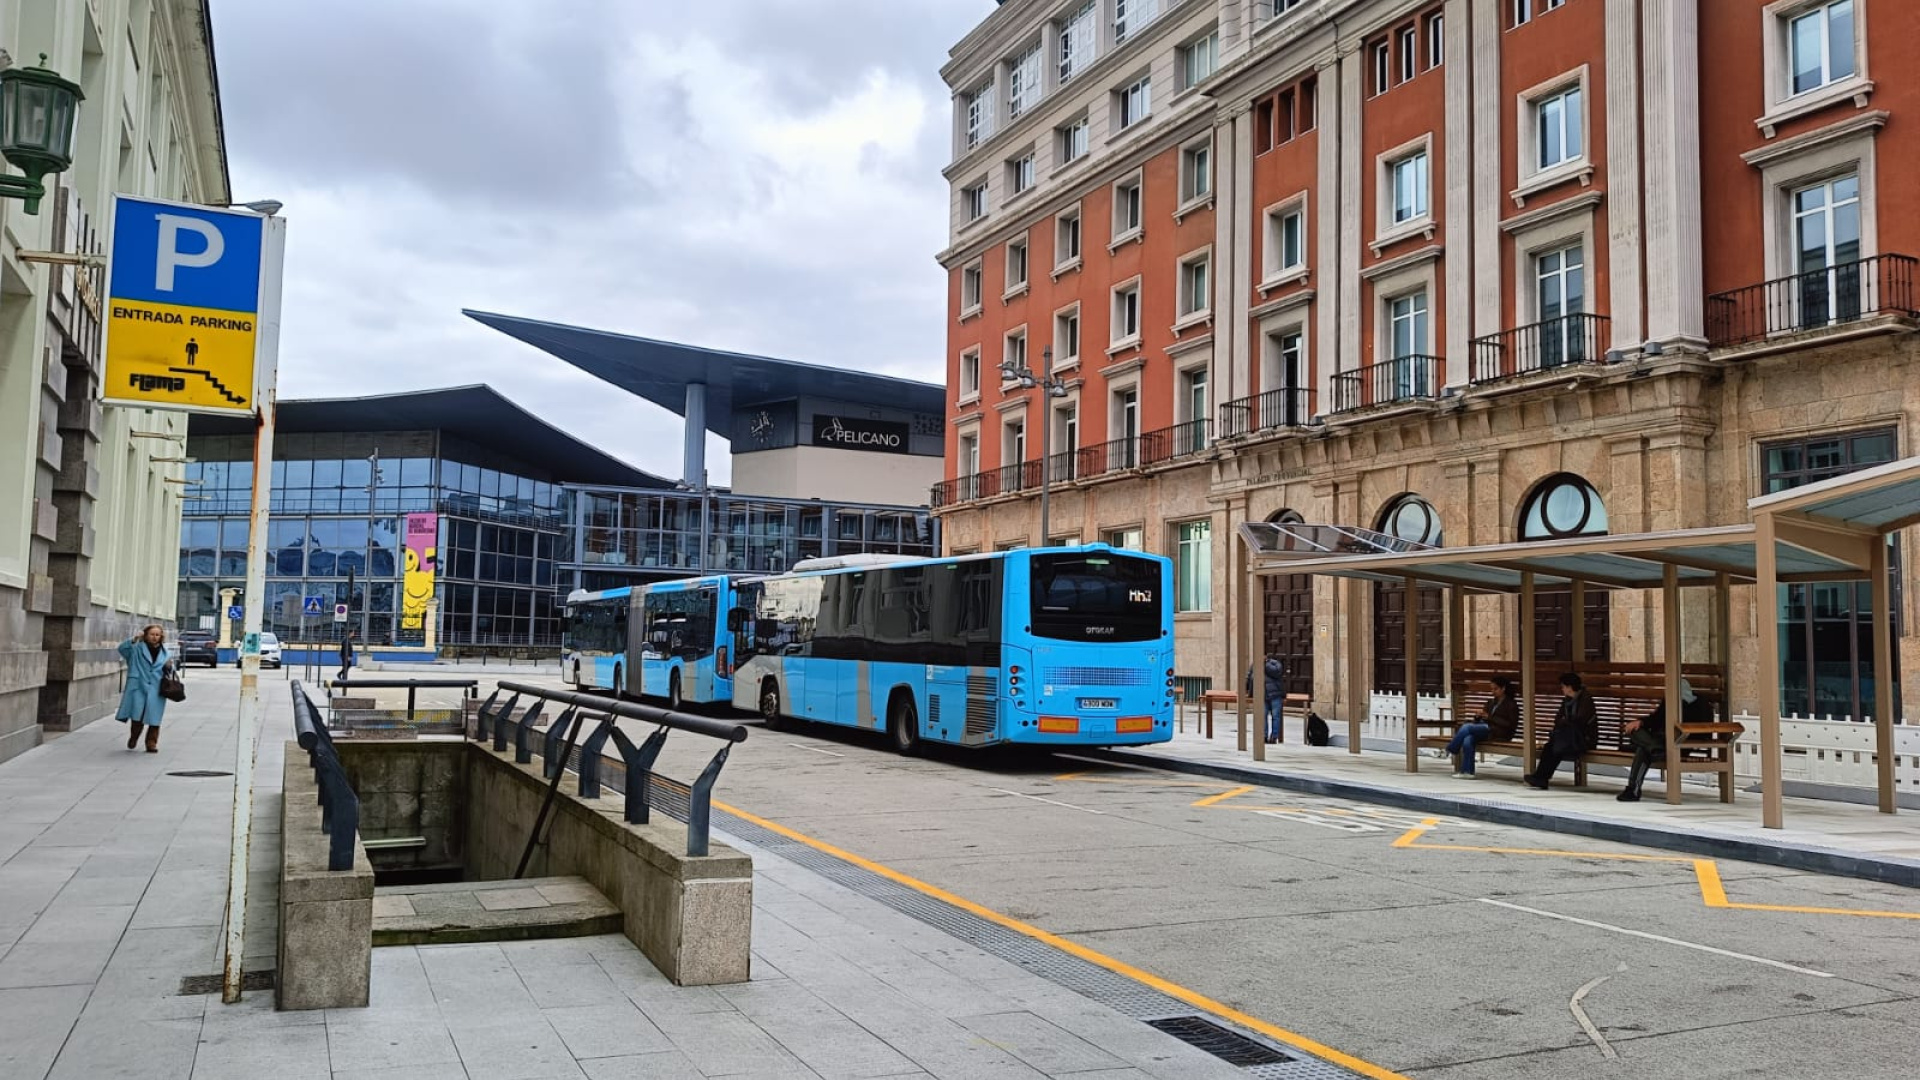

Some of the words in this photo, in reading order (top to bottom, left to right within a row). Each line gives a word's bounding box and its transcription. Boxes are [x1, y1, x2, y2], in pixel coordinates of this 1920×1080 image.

[154, 213, 225, 292] P
[113, 307, 184, 325] ENTRADA
[190, 316, 252, 332] PARKING
[836, 430, 900, 447] PELICANO
